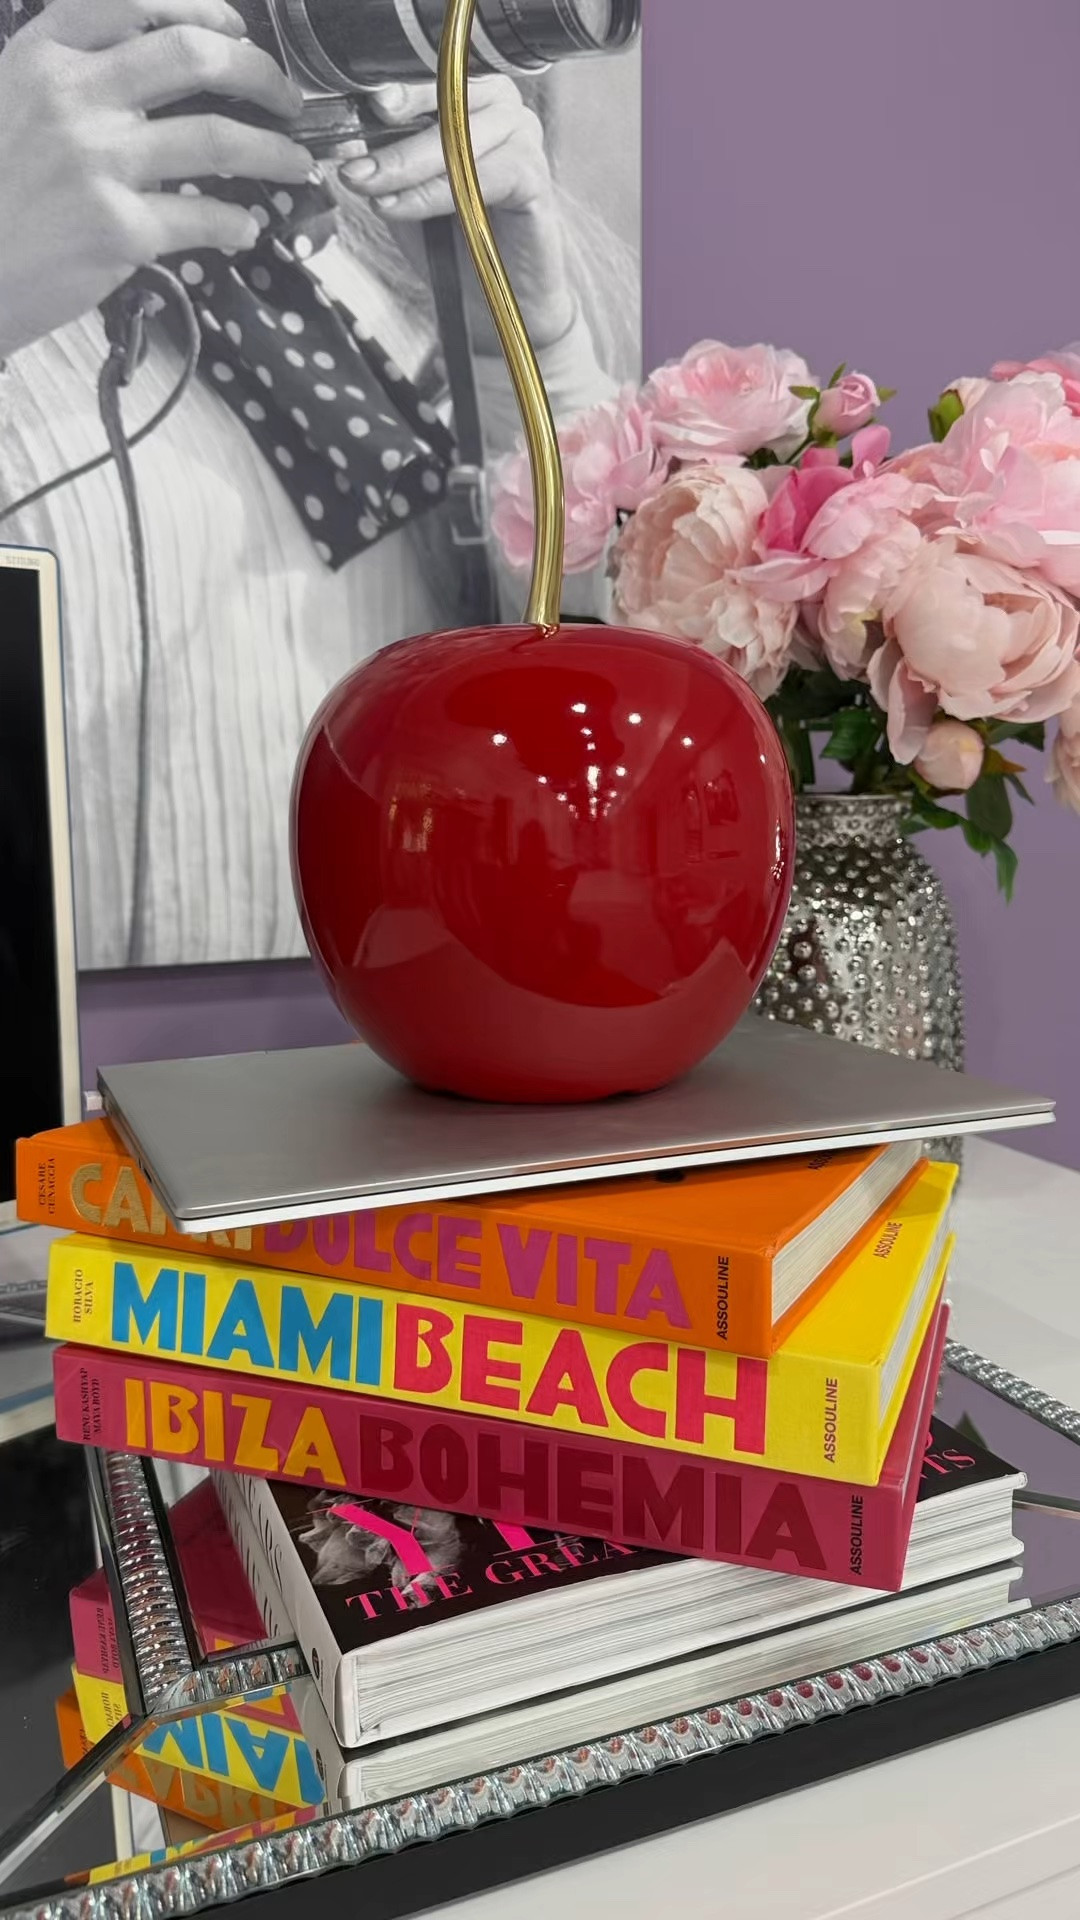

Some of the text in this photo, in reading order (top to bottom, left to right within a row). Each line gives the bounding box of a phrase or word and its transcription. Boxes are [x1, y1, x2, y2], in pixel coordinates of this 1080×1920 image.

[73, 1268, 83, 1323] HORACIO
[84, 1281, 94, 1315] SILVA
[496, 1223, 693, 1330] VITA
[716, 1255, 729, 1341] ASSOULINE
[112, 1261, 769, 1456] MIAMI BEACH
[82, 1413, 91, 1440] RENU
[91, 1378, 101, 1433] MAYA BOYD
[824, 1377, 838, 1463] ASSOULINE
[125, 1378, 347, 1486] IBIZA
[359, 1414, 827, 1570] BOHEMIA
[850, 1494, 864, 1575] ASSOULINE
[345, 1571, 473, 1621] THE
[485, 1541, 638, 1586] GREA
